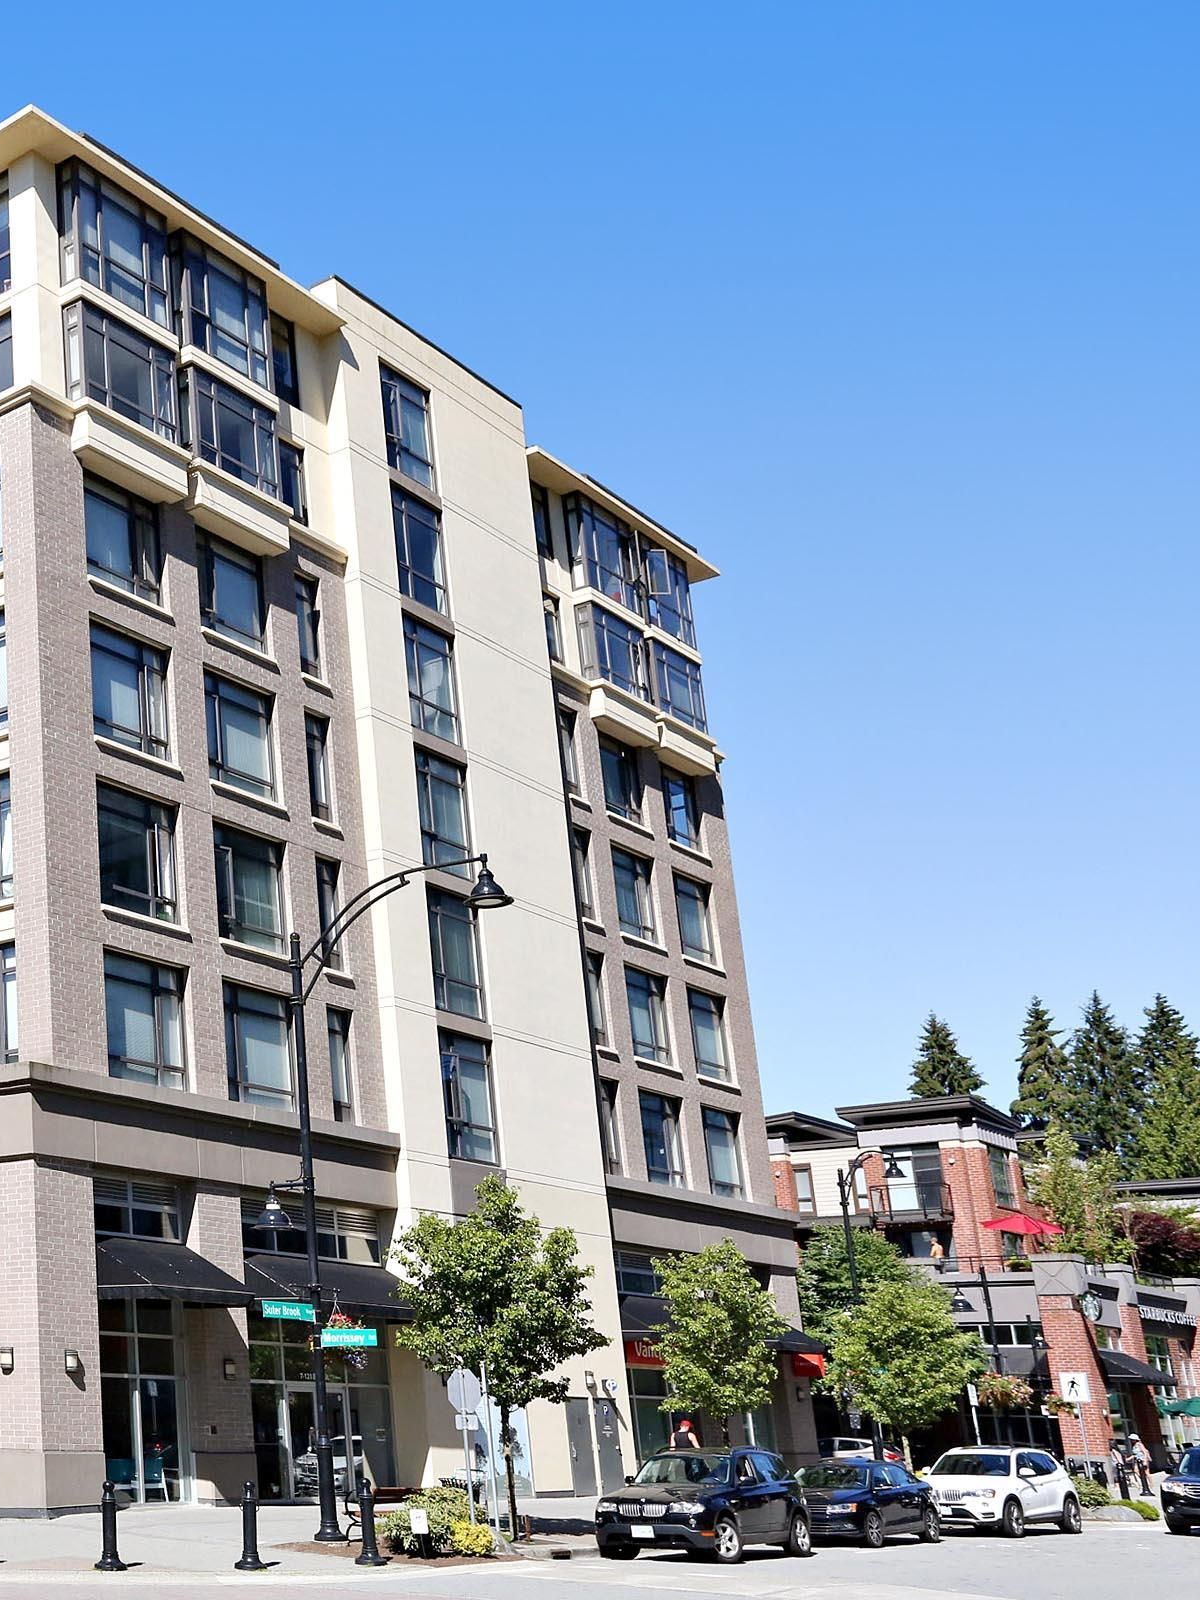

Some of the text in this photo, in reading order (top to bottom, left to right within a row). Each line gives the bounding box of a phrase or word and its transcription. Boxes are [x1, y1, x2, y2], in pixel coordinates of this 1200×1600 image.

[264, 1303, 281, 1316] Suter
[282, 1306, 301, 1317] Brook
[1139, 1306, 1197, 1327] STARBUCKS COFFEE
[323, 1332, 364, 1345] Morrissey
